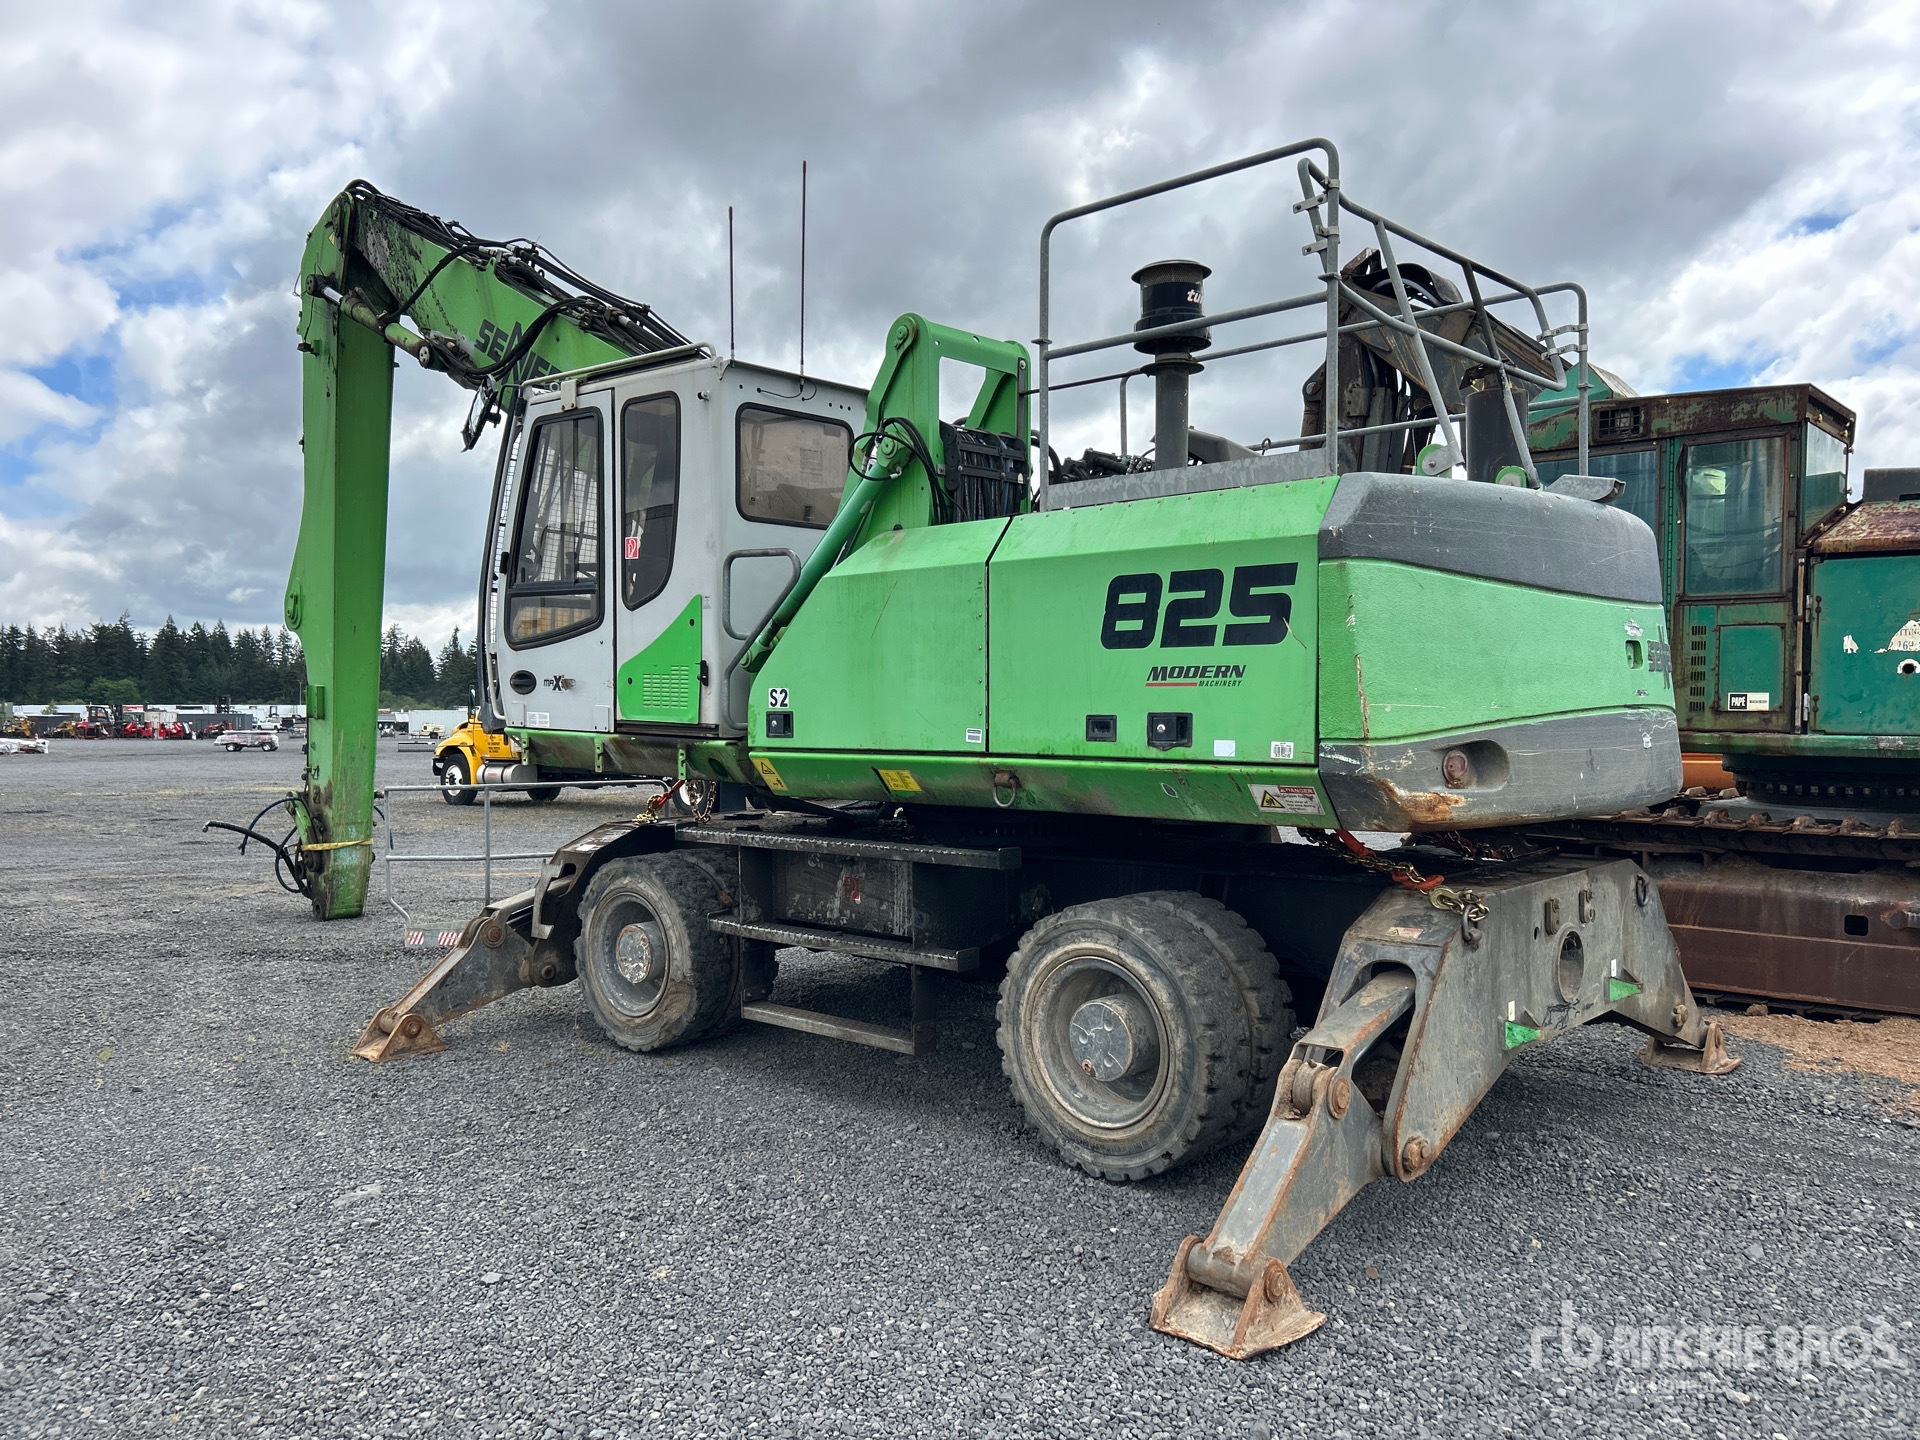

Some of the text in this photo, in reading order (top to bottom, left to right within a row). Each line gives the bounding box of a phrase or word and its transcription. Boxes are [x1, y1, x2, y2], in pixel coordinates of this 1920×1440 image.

[1187, 289, 1203, 304] tu
[1101, 562, 1299, 650] 825
[1147, 665, 1246, 682] MODERN
[1199, 680, 1243, 688] MACHINERY
[770, 688, 788, 708] S2
